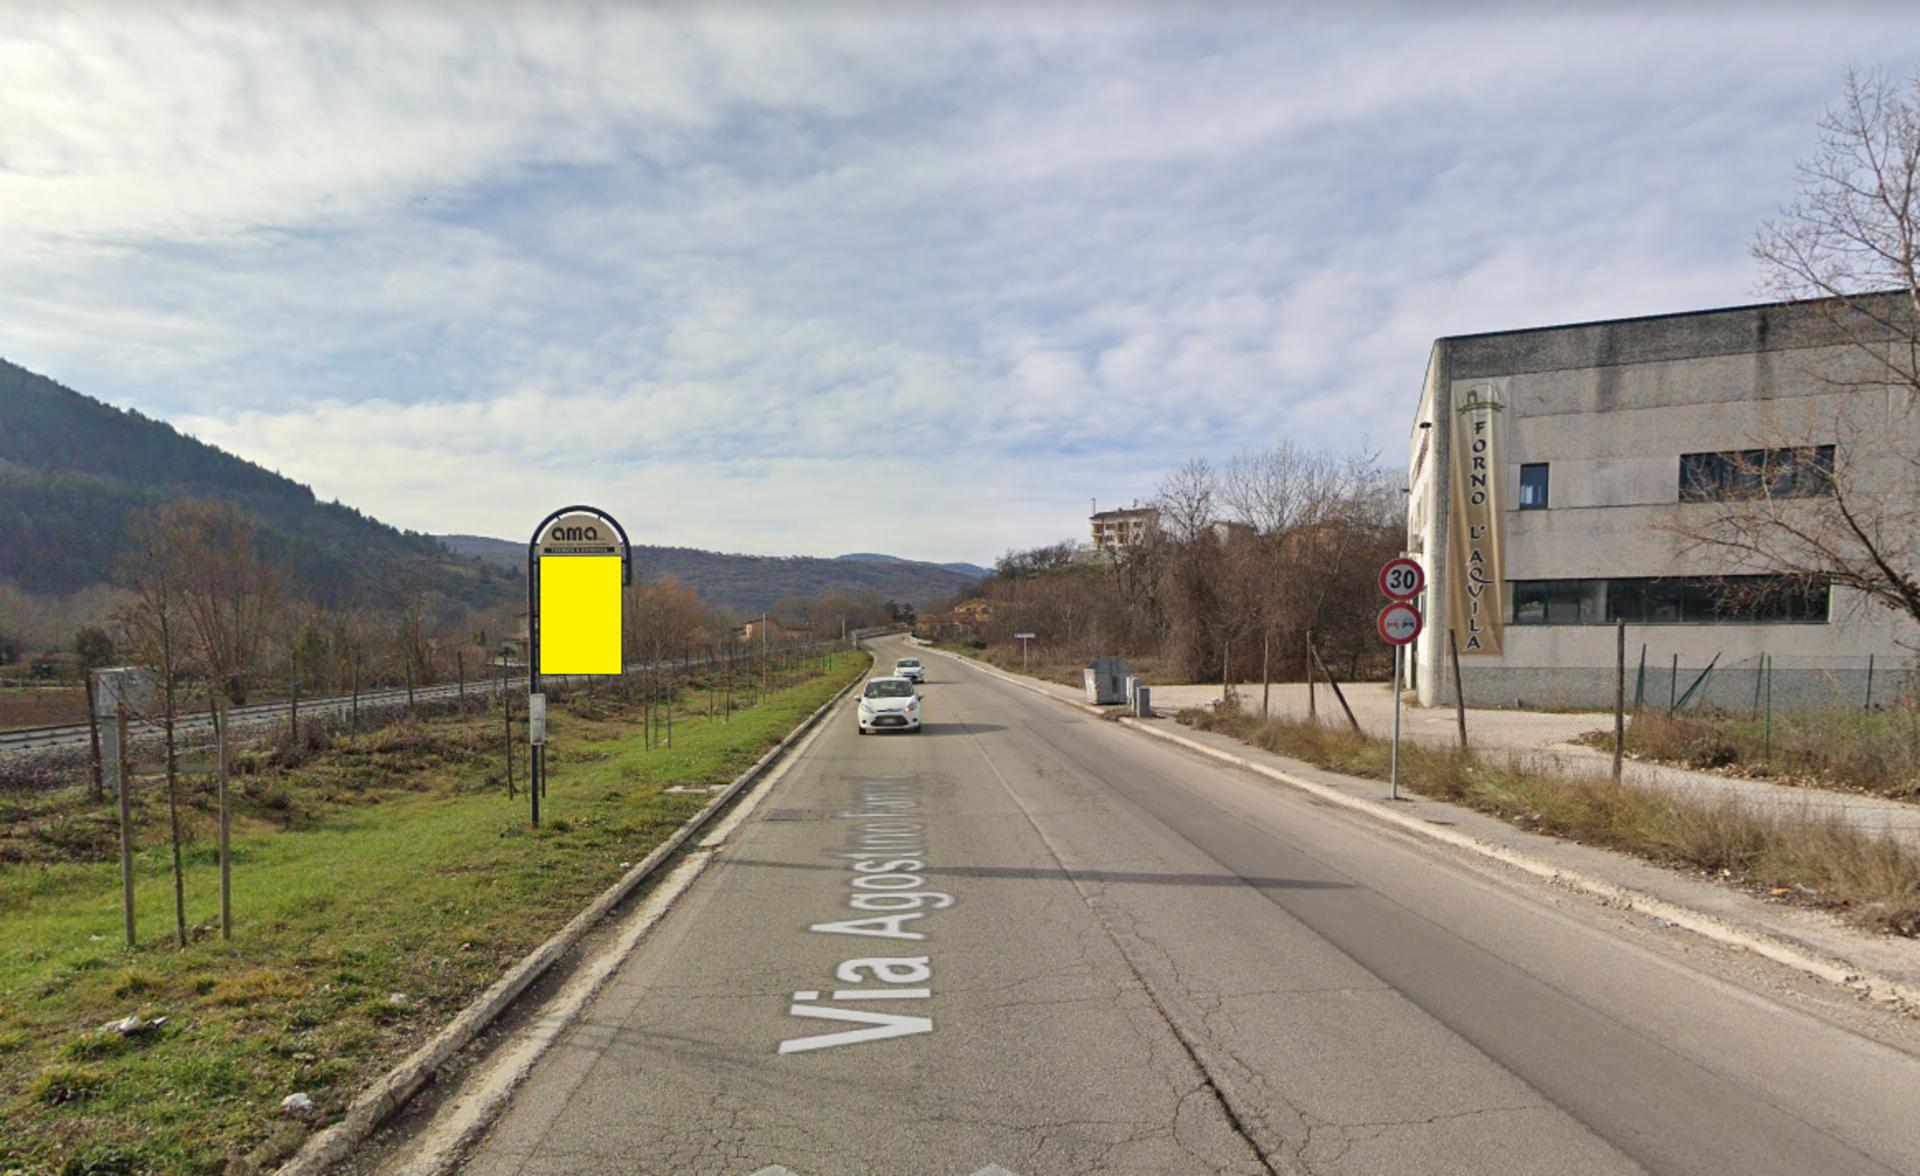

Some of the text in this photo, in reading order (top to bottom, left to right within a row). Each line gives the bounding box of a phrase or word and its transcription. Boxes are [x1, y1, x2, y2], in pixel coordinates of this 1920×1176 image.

[1471, 420, 1487, 505] FORNO
[551, 526, 597, 541] ama
[1390, 569, 1415, 589] 30
